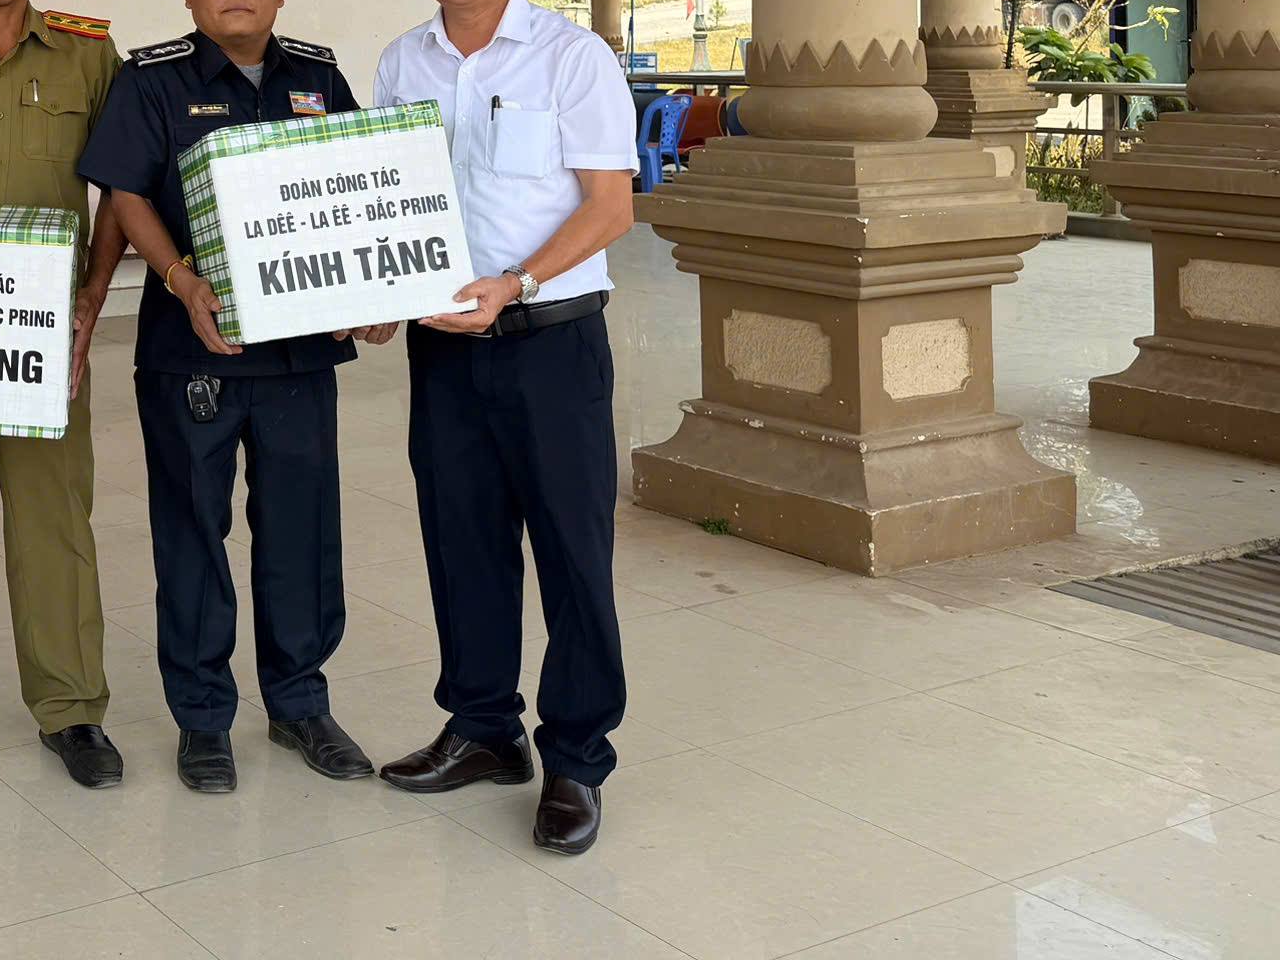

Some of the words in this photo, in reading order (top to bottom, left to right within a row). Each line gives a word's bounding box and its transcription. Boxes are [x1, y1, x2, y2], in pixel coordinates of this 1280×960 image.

[279, 177, 323, 202] ĐOÀN
[325, 172, 369, 196] CÔNG
[370, 166, 401, 189] TÁC
[244, 220, 265, 239] LA
[266, 211, 297, 236] DÊÊ
[309, 210, 330, 230] LA
[331, 203, 352, 227] ÊÊ
[365, 196, 397, 222] ĐẮC
[399, 193, 449, 217] PRING
[257, 250, 347, 296] KÍNH
[352, 236, 451, 286] TẶNG
[8, 308, 55, 329] PRING
